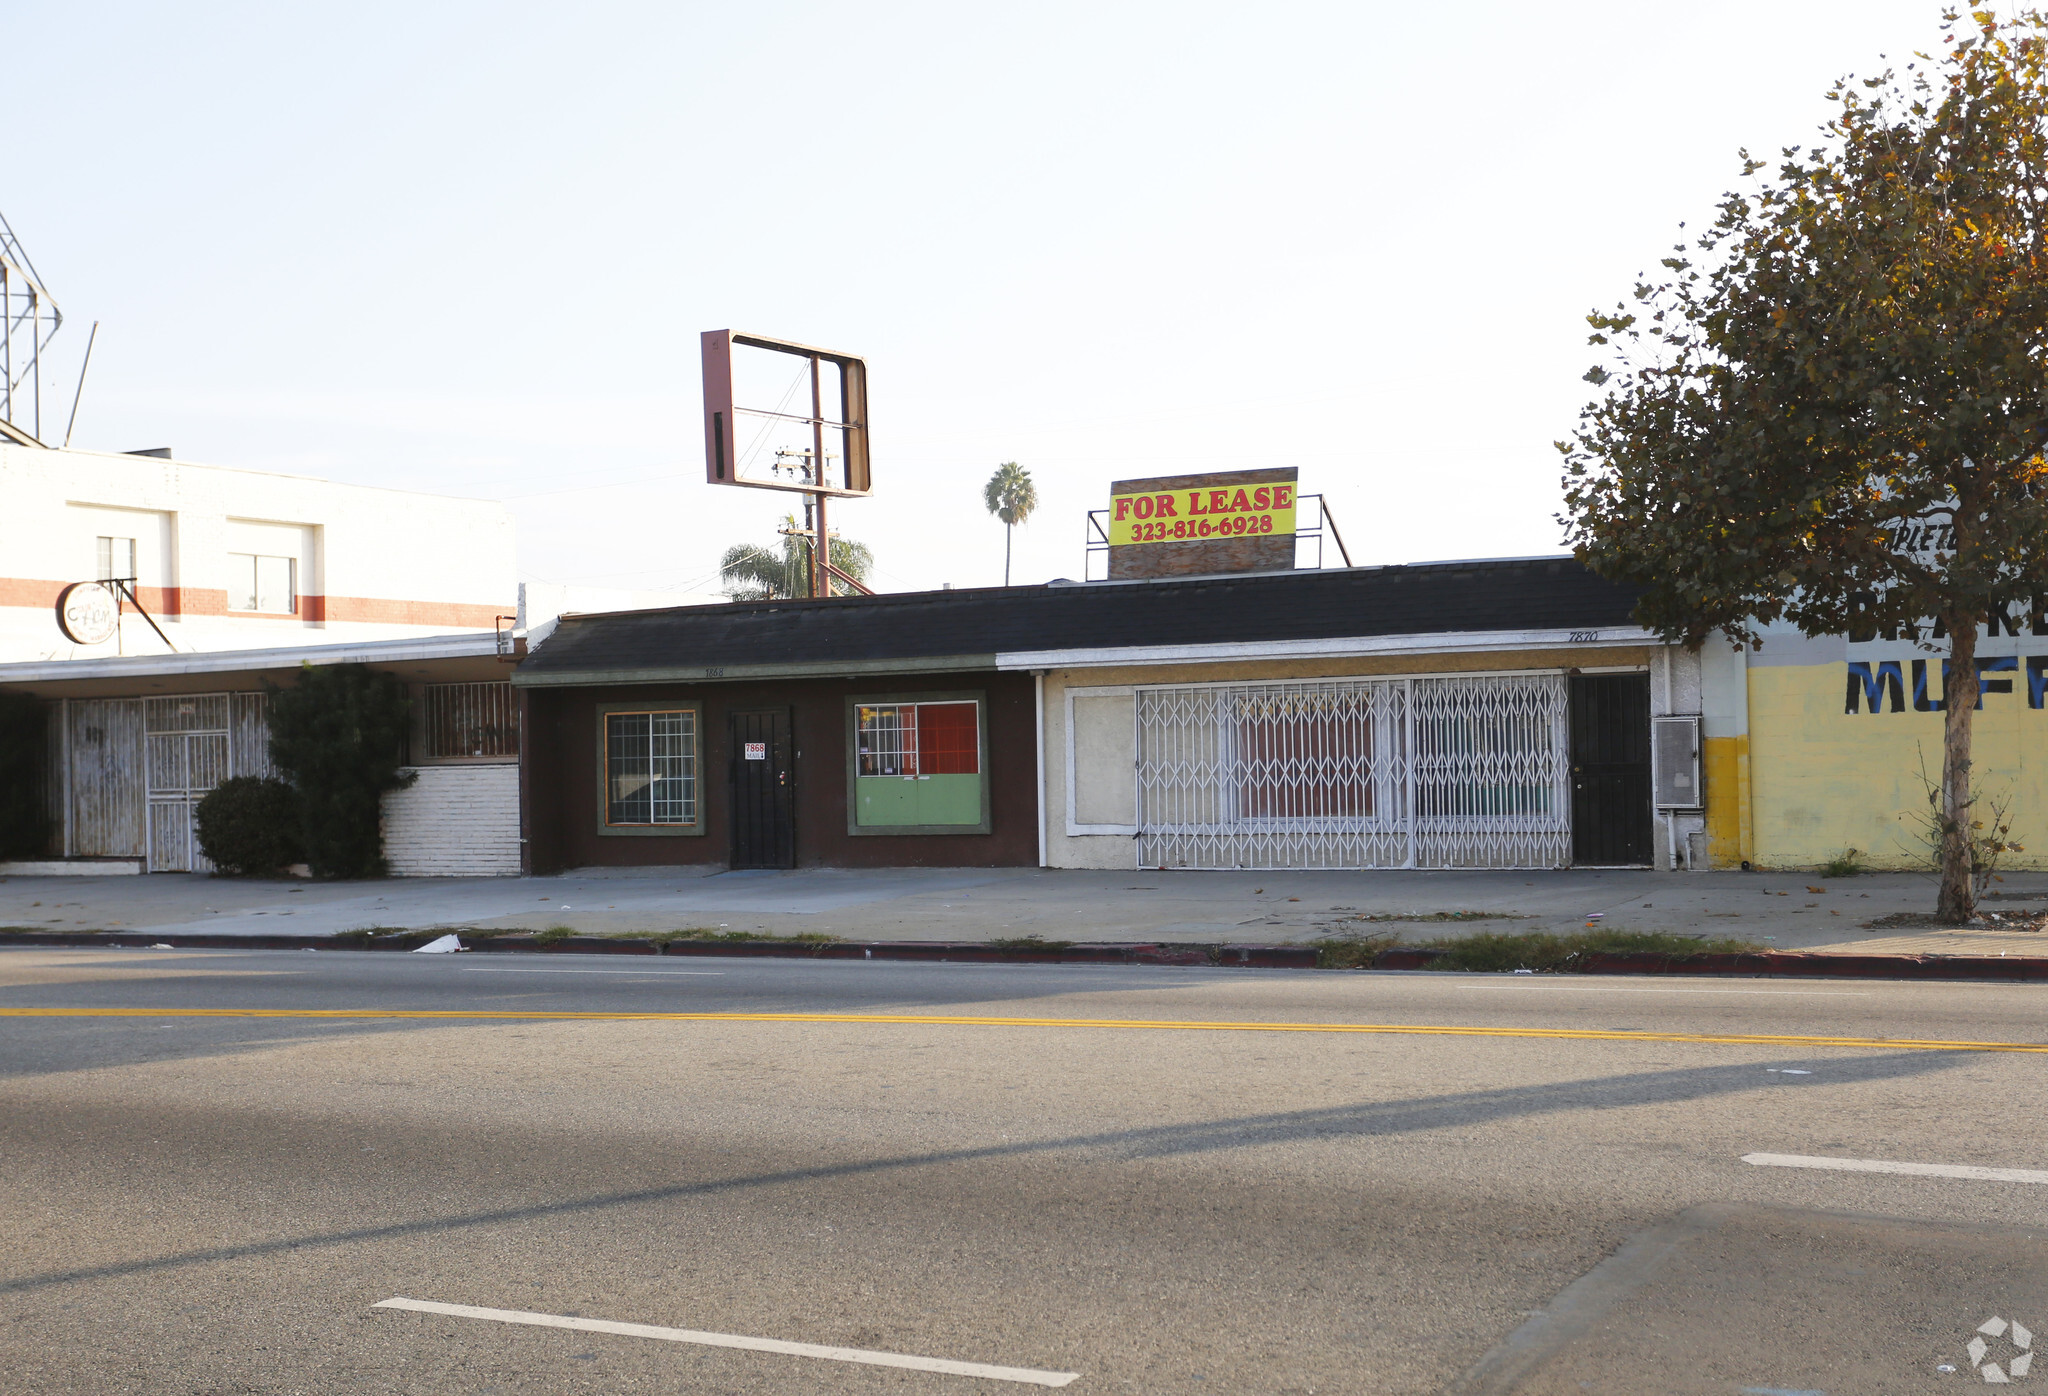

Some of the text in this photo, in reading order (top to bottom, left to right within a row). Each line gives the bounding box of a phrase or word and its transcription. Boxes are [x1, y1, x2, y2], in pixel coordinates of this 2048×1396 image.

[1115, 485, 1292, 521] FOR LEASE
[1131, 515, 1272, 542] 323-816-6928
[1569, 630, 1598, 642] 7870
[746, 743, 764, 752] 7868
